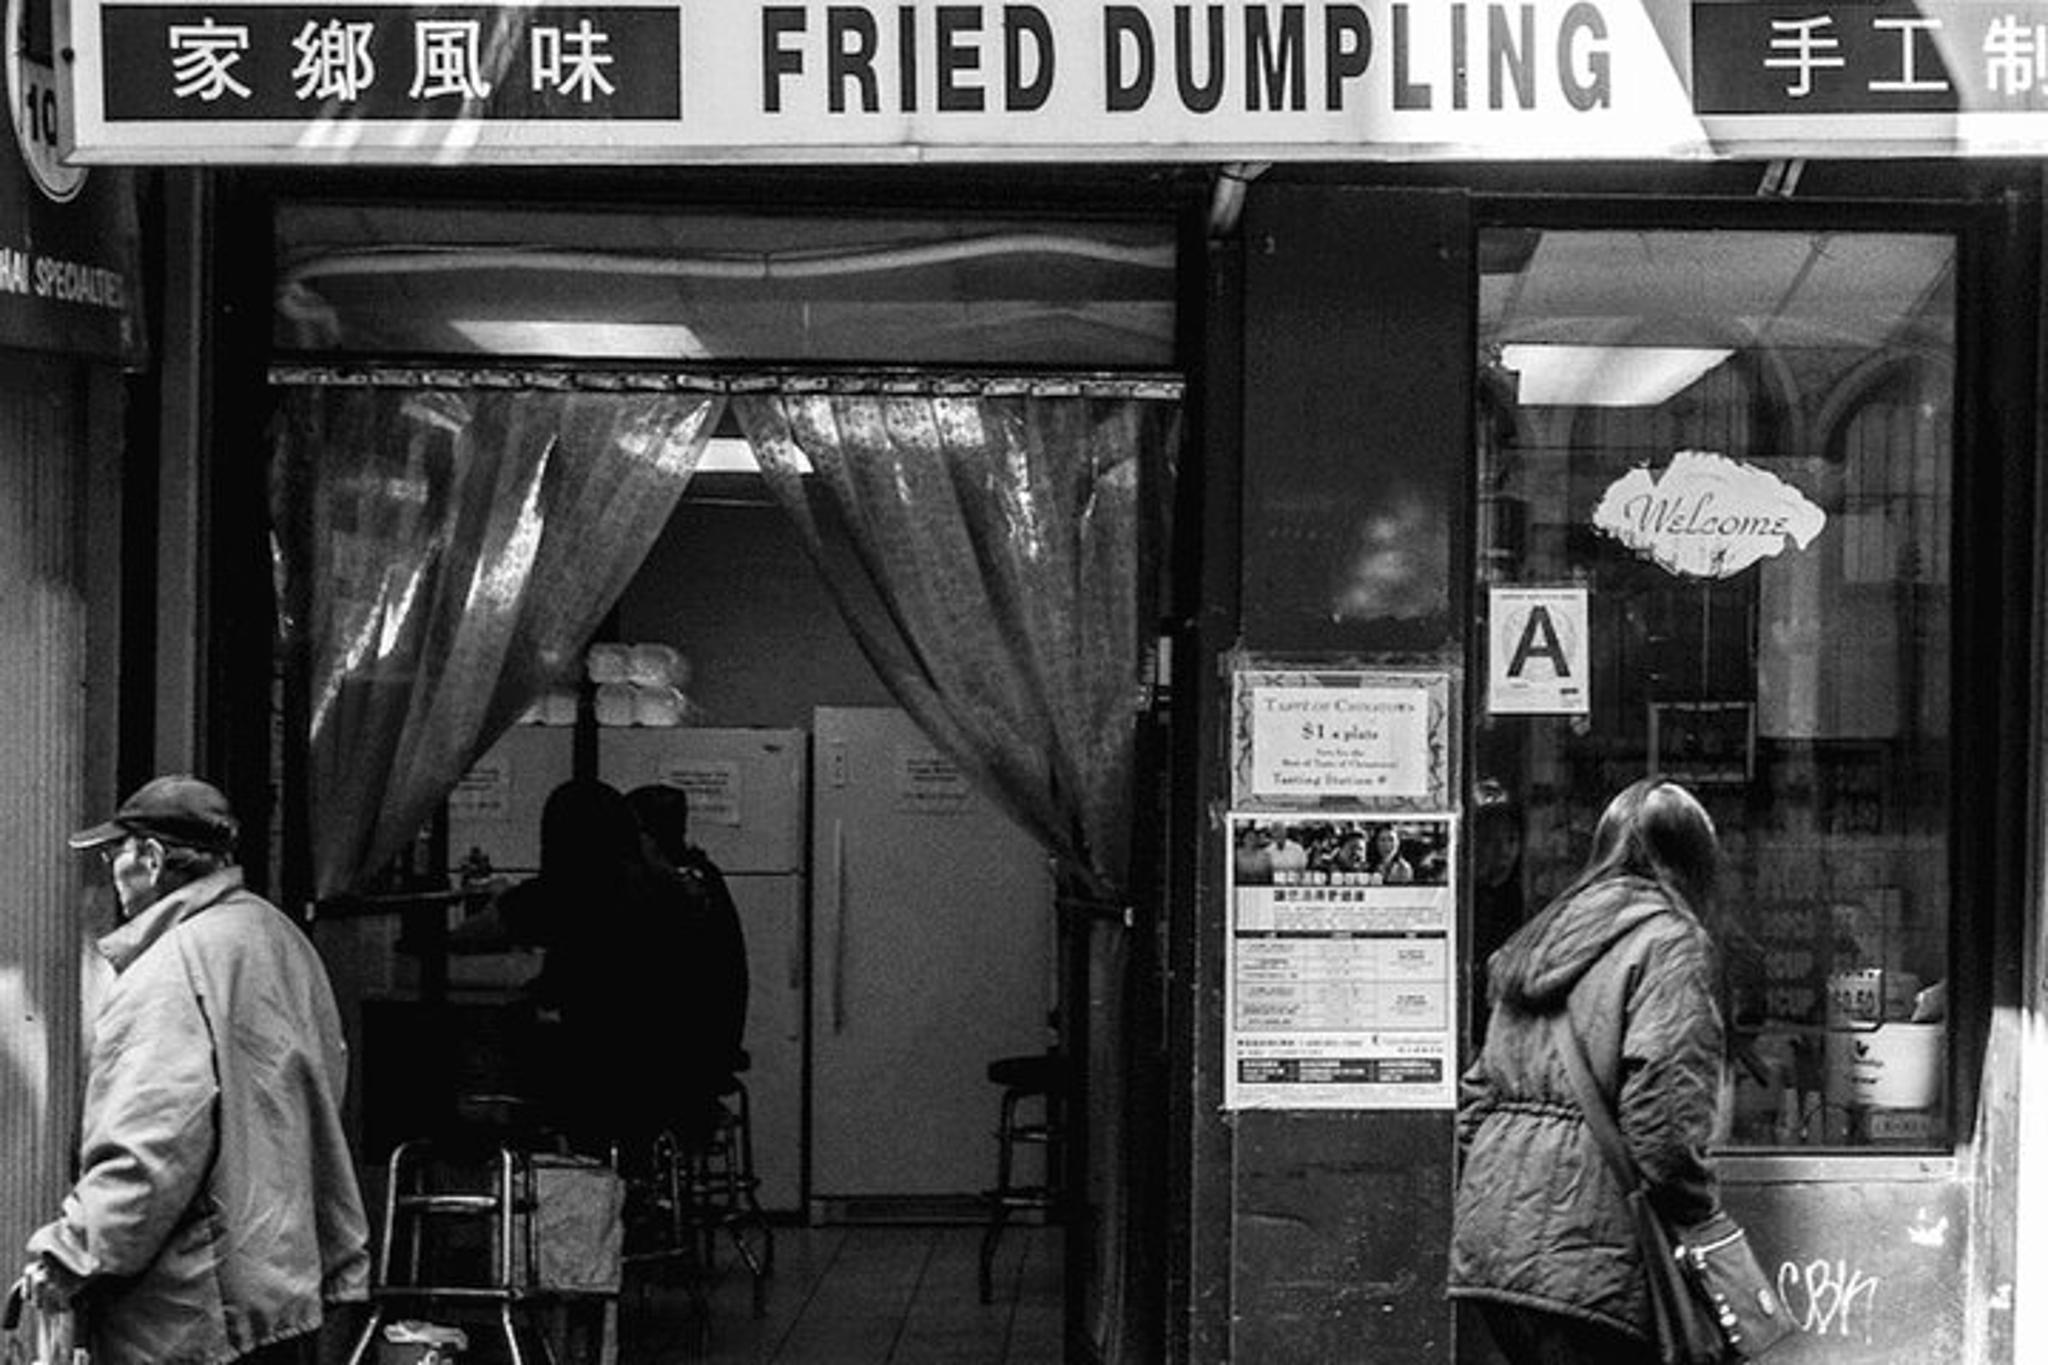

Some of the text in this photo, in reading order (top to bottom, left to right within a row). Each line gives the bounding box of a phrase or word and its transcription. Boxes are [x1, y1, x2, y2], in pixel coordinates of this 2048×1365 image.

[167, 18, 617, 101] 家鄉風味
[761, 3, 1611, 114] FRIED DUMPLING
[1624, 491, 1791, 537] Welcome
[1506, 604, 1572, 679] A
